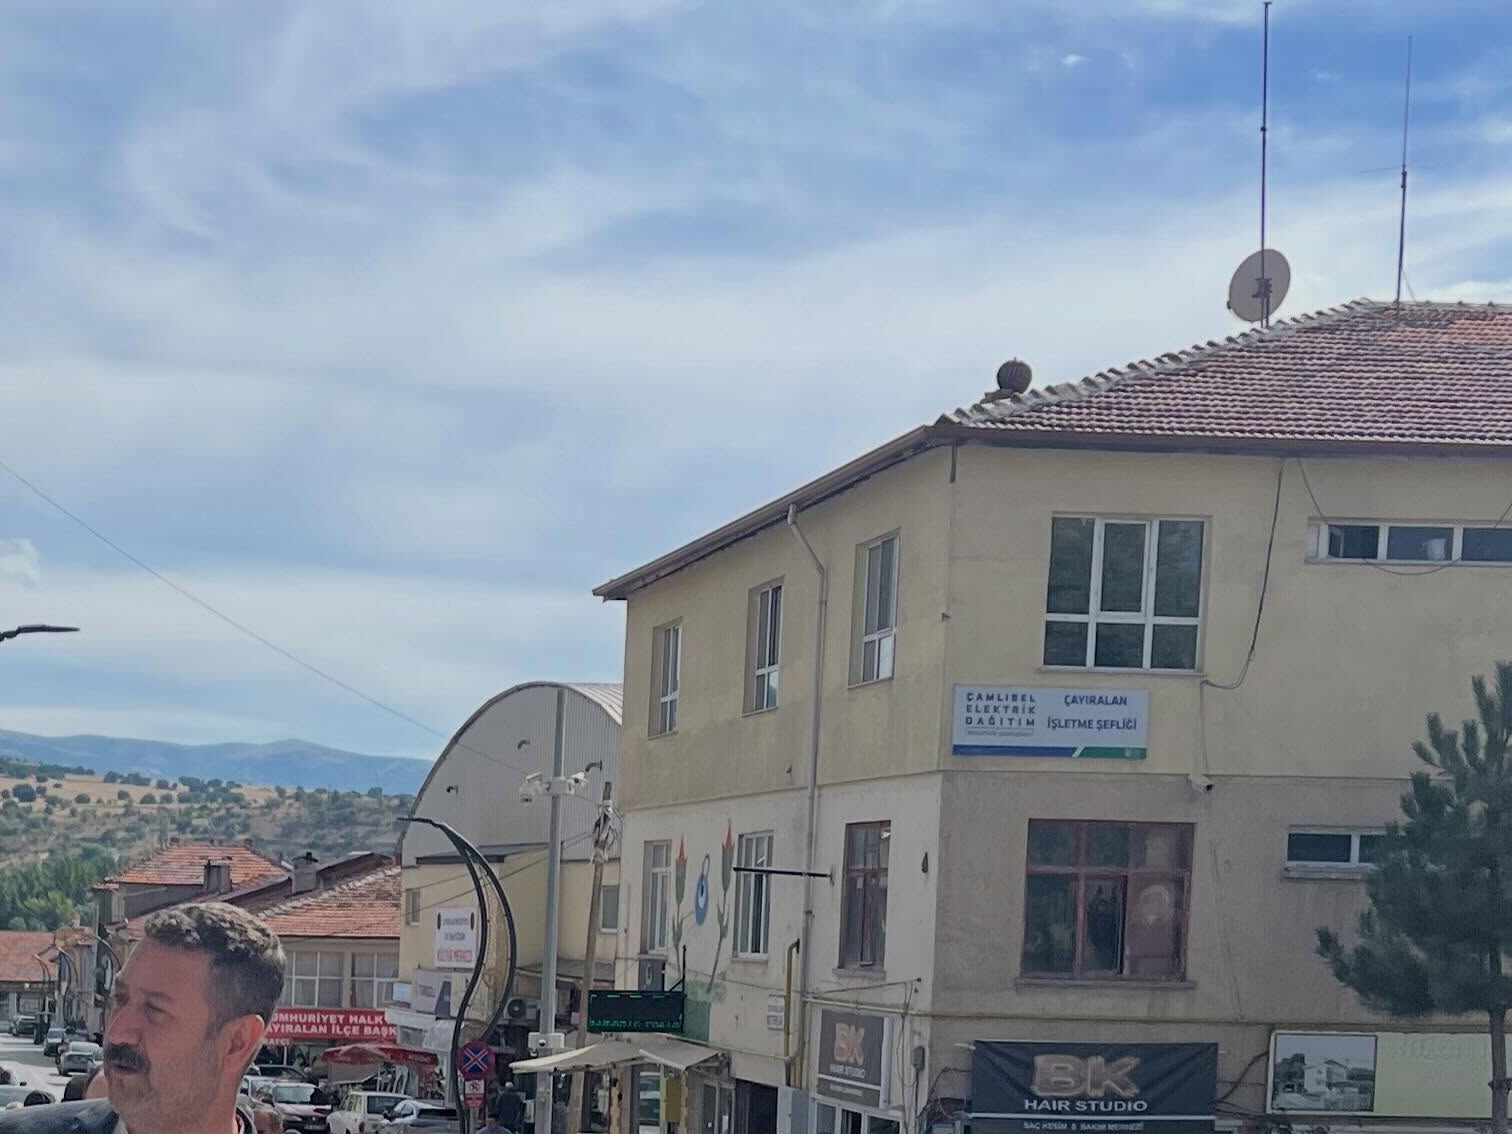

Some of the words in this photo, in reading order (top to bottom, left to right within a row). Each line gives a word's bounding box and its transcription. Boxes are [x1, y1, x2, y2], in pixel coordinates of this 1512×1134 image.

[967, 692, 1036, 703] ÇAMLIBEL
[1064, 694, 1128, 707] ÇAYIRALAN
[966, 703, 1036, 714] ELEKTRİK
[965, 716, 1035, 727] DAĞITIM
[1047, 716, 1094, 731] İŞLETME
[1096, 716, 1137, 731] ŞEFLİĞİ
[272, 1013, 345, 1024] UMHURİYET
[349, 1014, 383, 1025] HALK
[268, 1023, 328, 1034] AYIRALAN
[331, 1023, 360, 1038] İLÇE
[834, 1023, 865, 1066] BK
[1032, 1054, 1141, 1098] BK
[1024, 1099, 1070, 1111] HAIR
[1075, 1100, 1148, 1111] STUDIO
